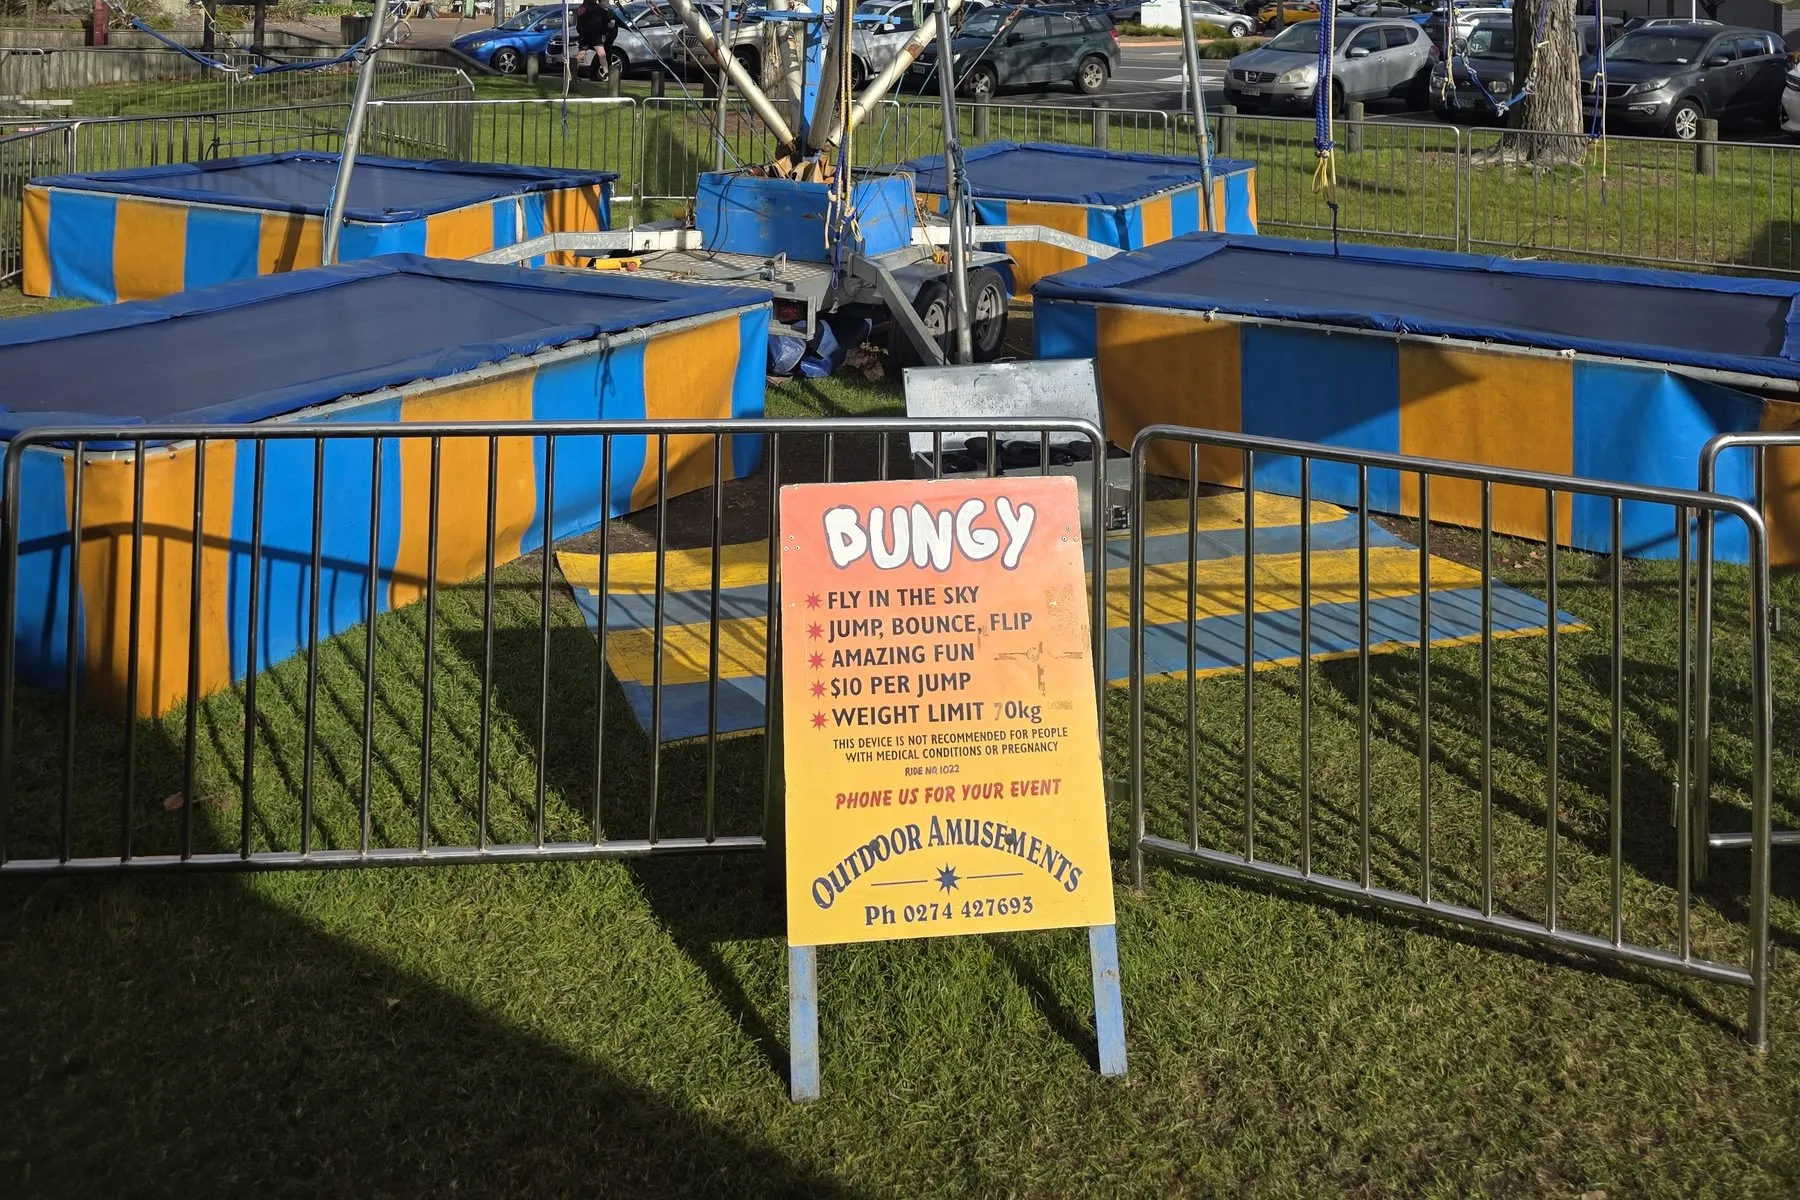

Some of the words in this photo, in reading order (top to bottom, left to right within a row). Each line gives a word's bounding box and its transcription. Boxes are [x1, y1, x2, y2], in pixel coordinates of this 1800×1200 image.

[822, 496, 1037, 571] BUNGY
[828, 591, 861, 609] FLY
[869, 590, 889, 607] IN
[897, 587, 936, 606] THE
[944, 585, 980, 605] SKY
[828, 619, 884, 643] JUMP,
[892, 615, 982, 635] BOUNCE,
[990, 613, 1033, 632] FLIP
[831, 645, 926, 668] AMAZING
[935, 643, 975, 662] FUN
[831, 677, 862, 699] $10
[871, 675, 910, 695] PER
[918, 672, 971, 697] JUMP
[832, 705, 920, 727] WEIGHT
[929, 702, 984, 723] LIMIT
[994, 701, 1041, 724] 70kg
[833, 738, 855, 749] THIS
[859, 737, 892, 748] DEVICE
[896, 736, 904, 746] IS
[908, 734, 927, 745] NOT
[931, 731, 1006, 744] RECOMMENDED
[1010, 729, 1029, 739] FOR
[1032, 727, 1068, 738] PEOPLE
[846, 751, 873, 763] WITH
[877, 748, 919, 761] MEDICAL
[922, 744, 982, 759] CONDITIONS
[985, 743, 999, 755] OR
[1002, 741, 1058, 754] PREGNANCY
[905, 766, 923, 776] RIDE
[835, 789, 891, 810] PHONE
[898, 788, 919, 804] US
[925, 785, 955, 803] FOR
[962, 782, 1004, 800] YOUR
[1011, 779, 1062, 798] EVENT
[812, 824, 922, 910] OUTDOOR
[928, 815, 1083, 893] AMUSEMENTS
[865, 905, 896, 925] Ph
[904, 901, 952, 923] 0274
[961, 896, 1033, 918] 427693
